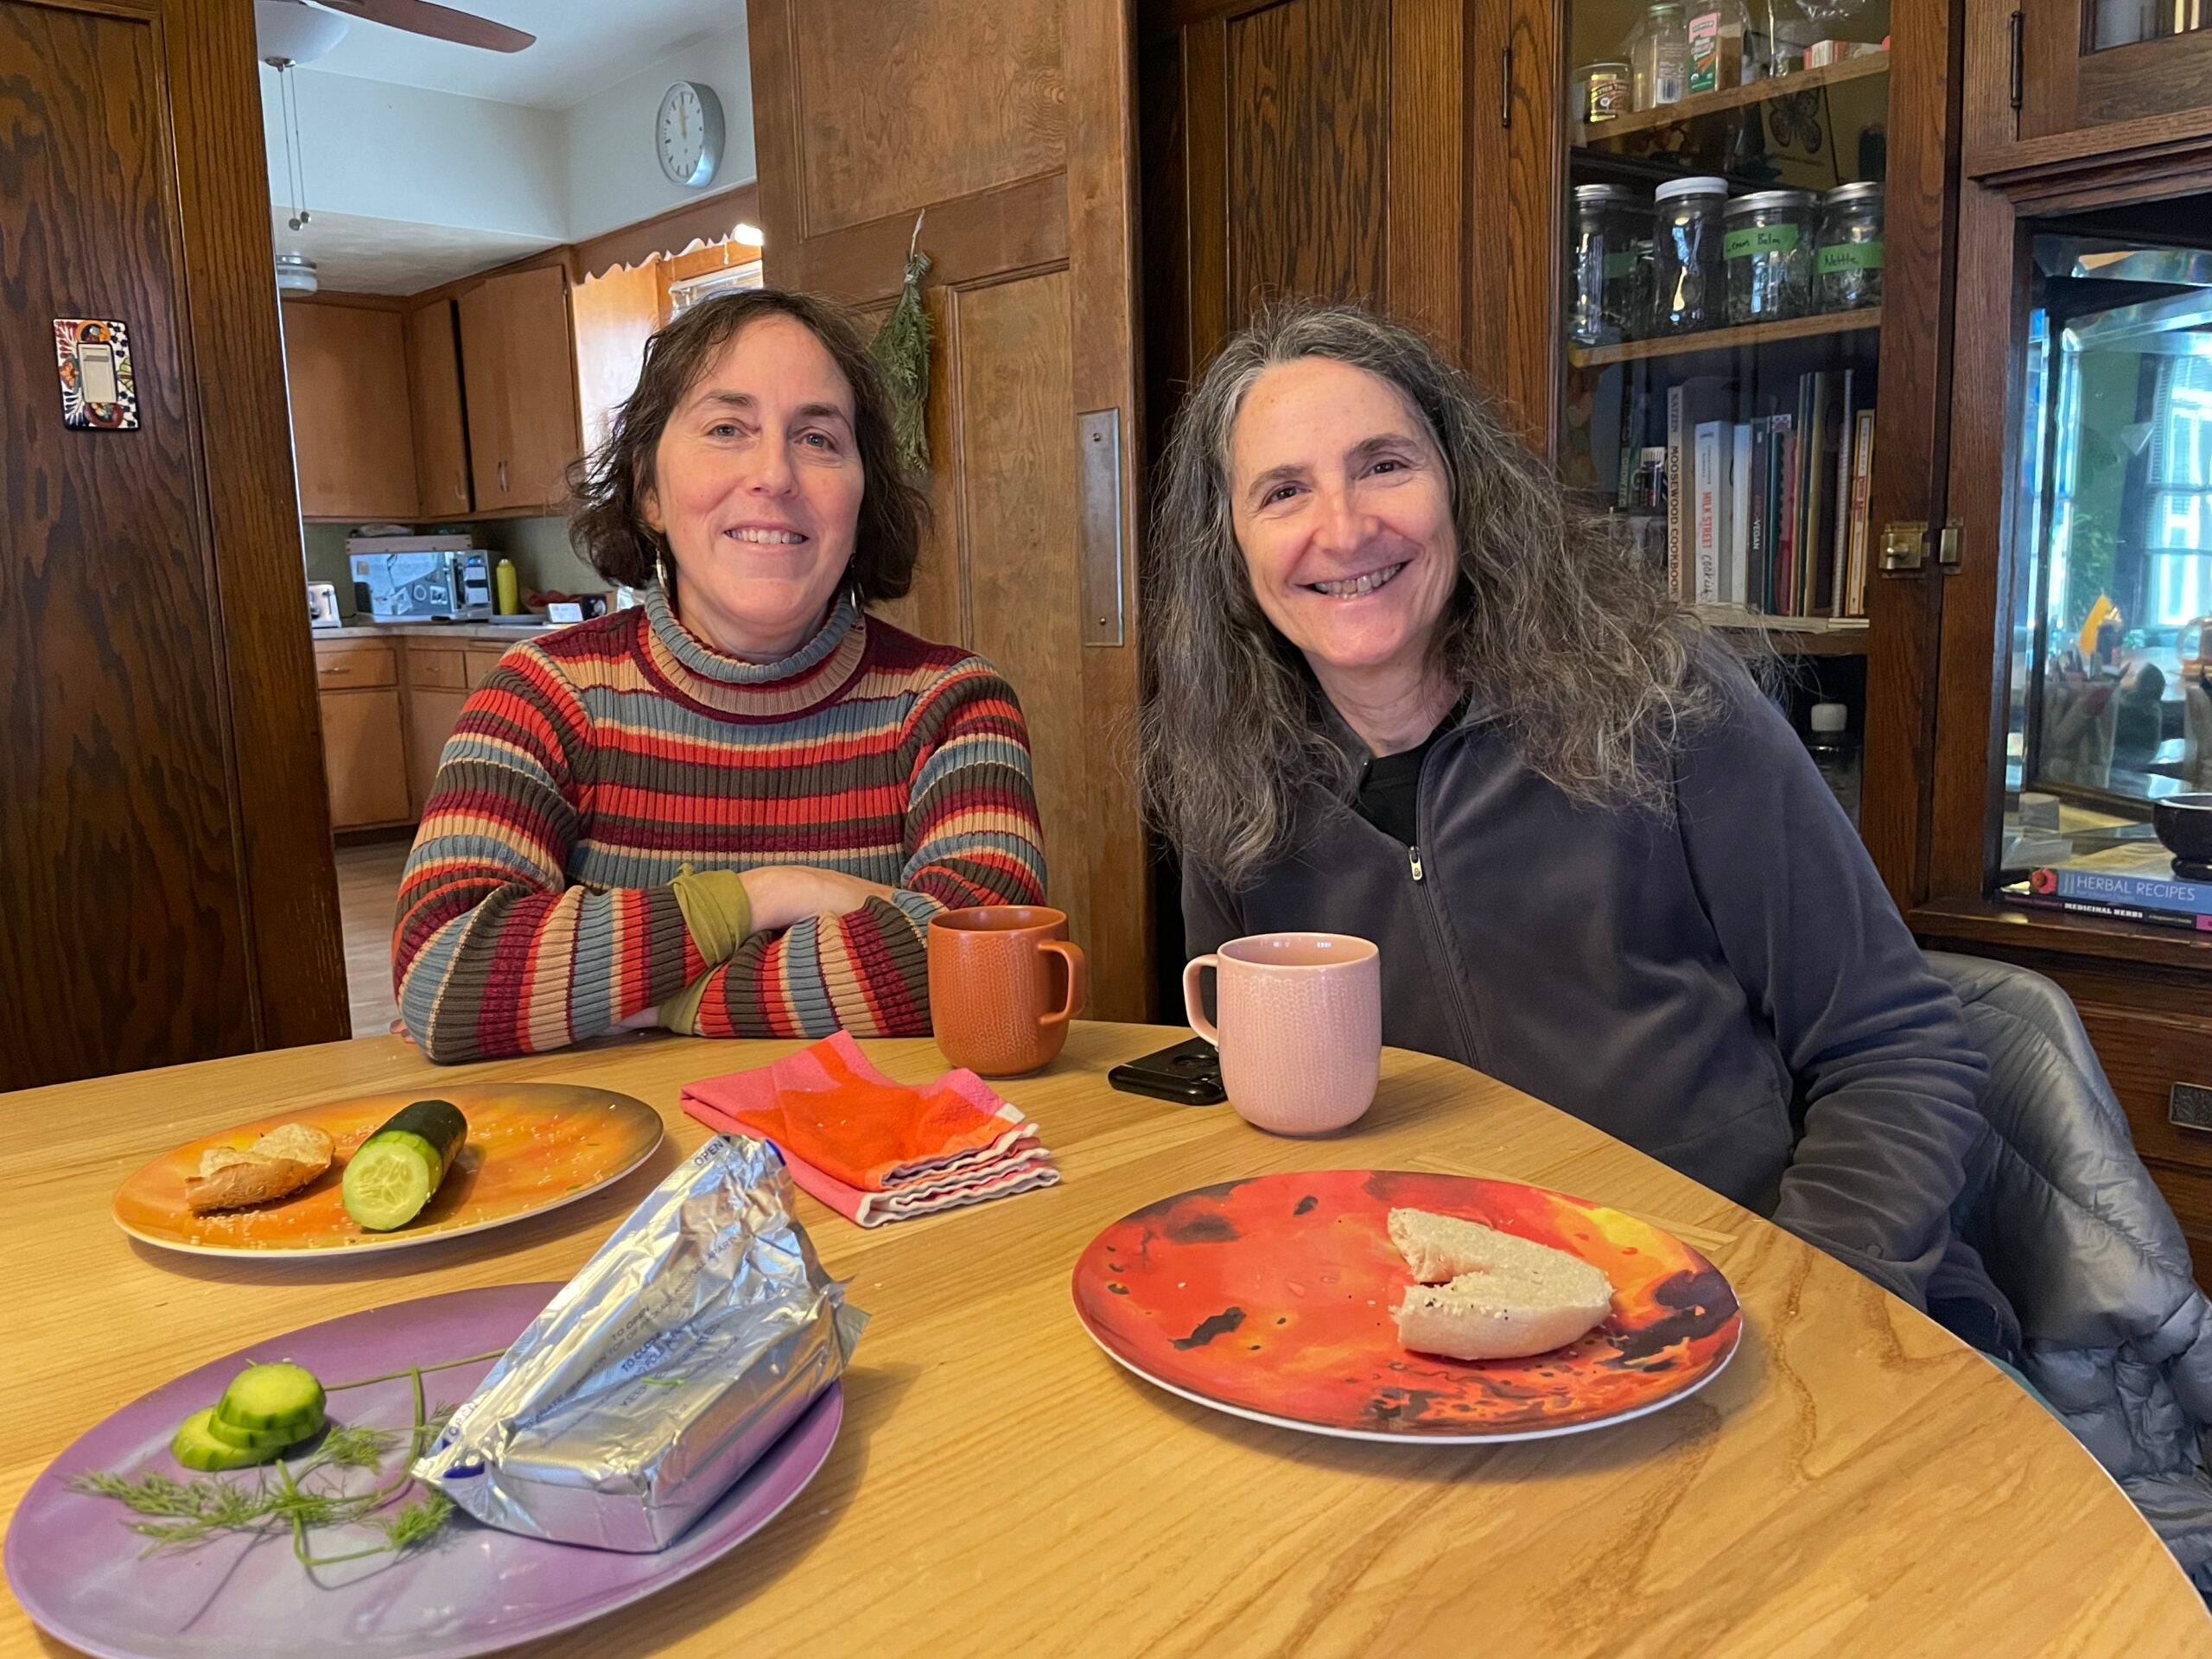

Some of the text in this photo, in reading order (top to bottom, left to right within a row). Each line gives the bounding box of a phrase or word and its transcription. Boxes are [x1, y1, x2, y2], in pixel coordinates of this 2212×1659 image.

[1670, 445, 1679, 596] MOOSEWOOD COOKBOOK
[1701, 492, 1712, 549] MILK STREET
[2077, 874, 2131, 894] HERBAL
[2136, 881, 2196, 901] RECIPES
[2064, 902, 2143, 918] MEDICINAL HERBS
[695, 1140, 724, 1166] OPEN
[612, 1328, 624, 1340] TO
[621, 1357, 635, 1372] TO
[621, 1383, 648, 1406] KEEP
